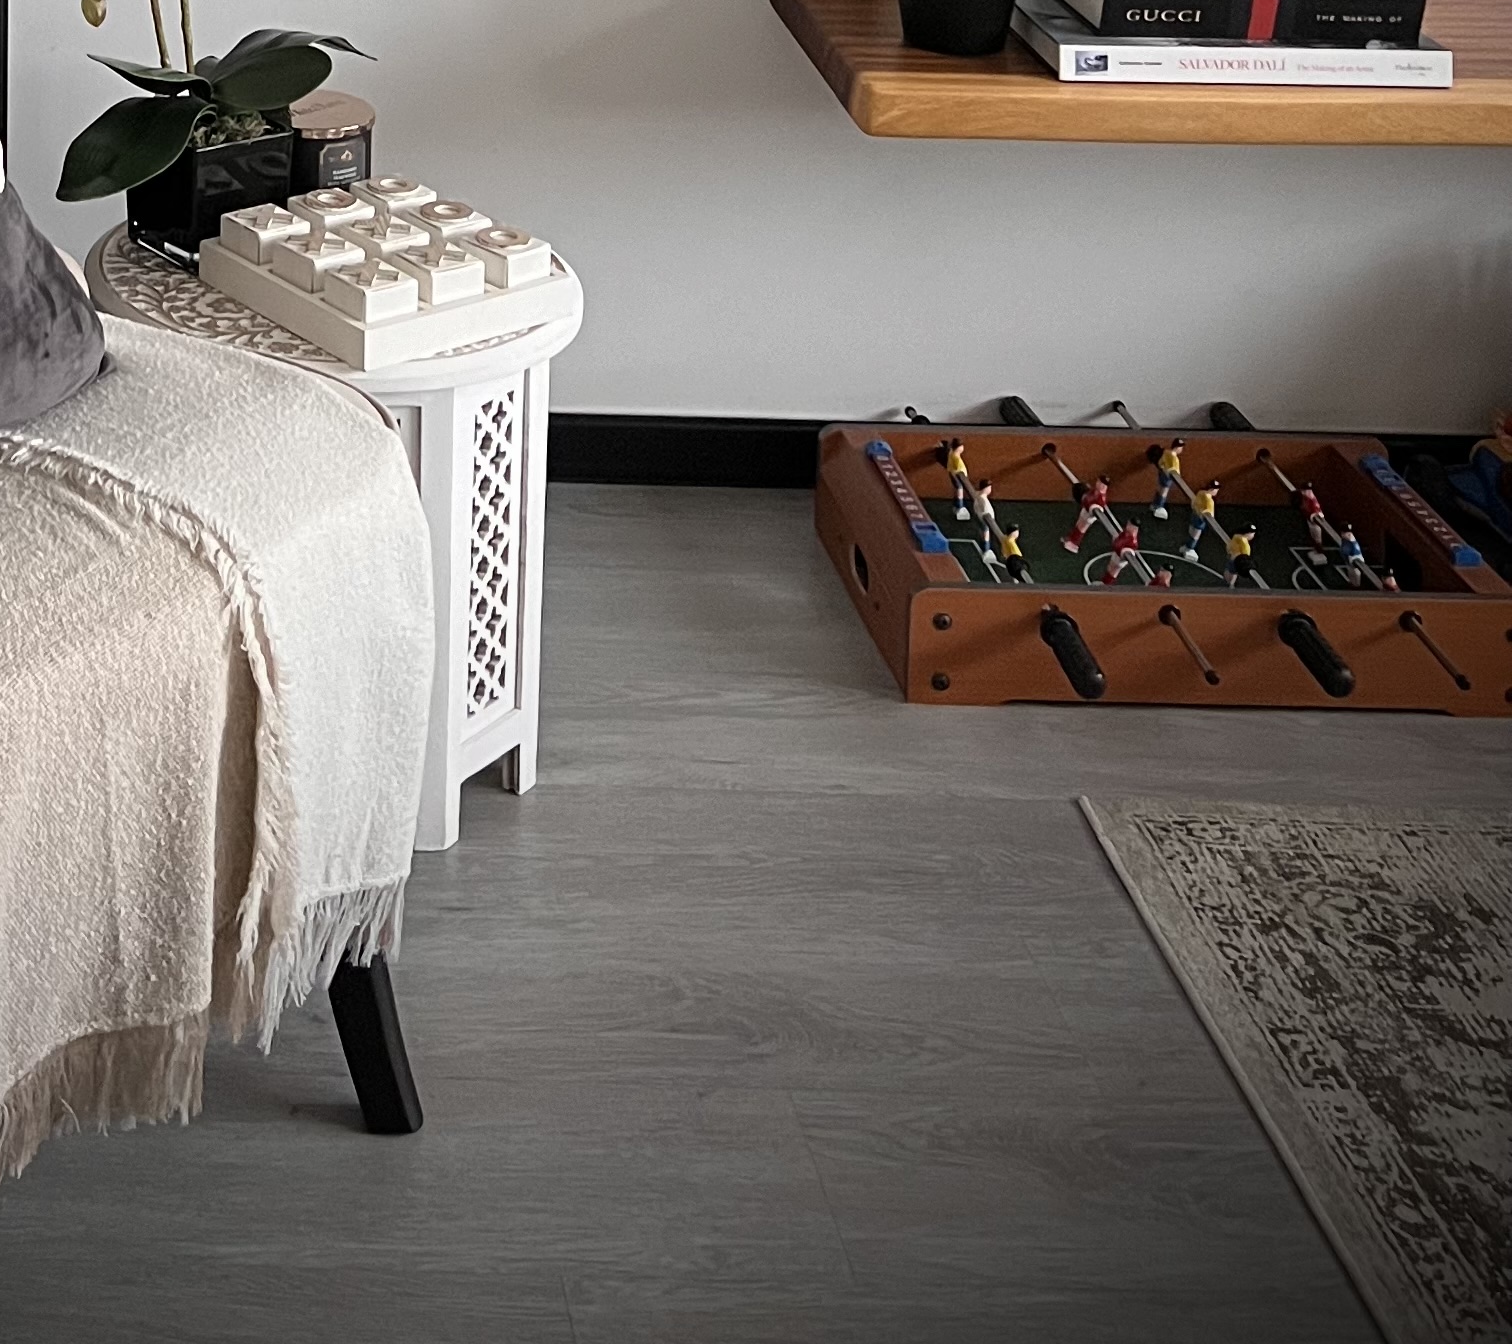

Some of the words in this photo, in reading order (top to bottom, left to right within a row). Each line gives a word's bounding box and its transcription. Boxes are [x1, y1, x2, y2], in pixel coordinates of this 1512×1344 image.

[1126, 9, 1202, 23] GUCCI
[1316, 14, 1336, 22] THE
[1342, 15, 1383, 23] MAKING
[1389, 15, 1403, 23] OF
[1178, 58, 1251, 72] SALVADOR
